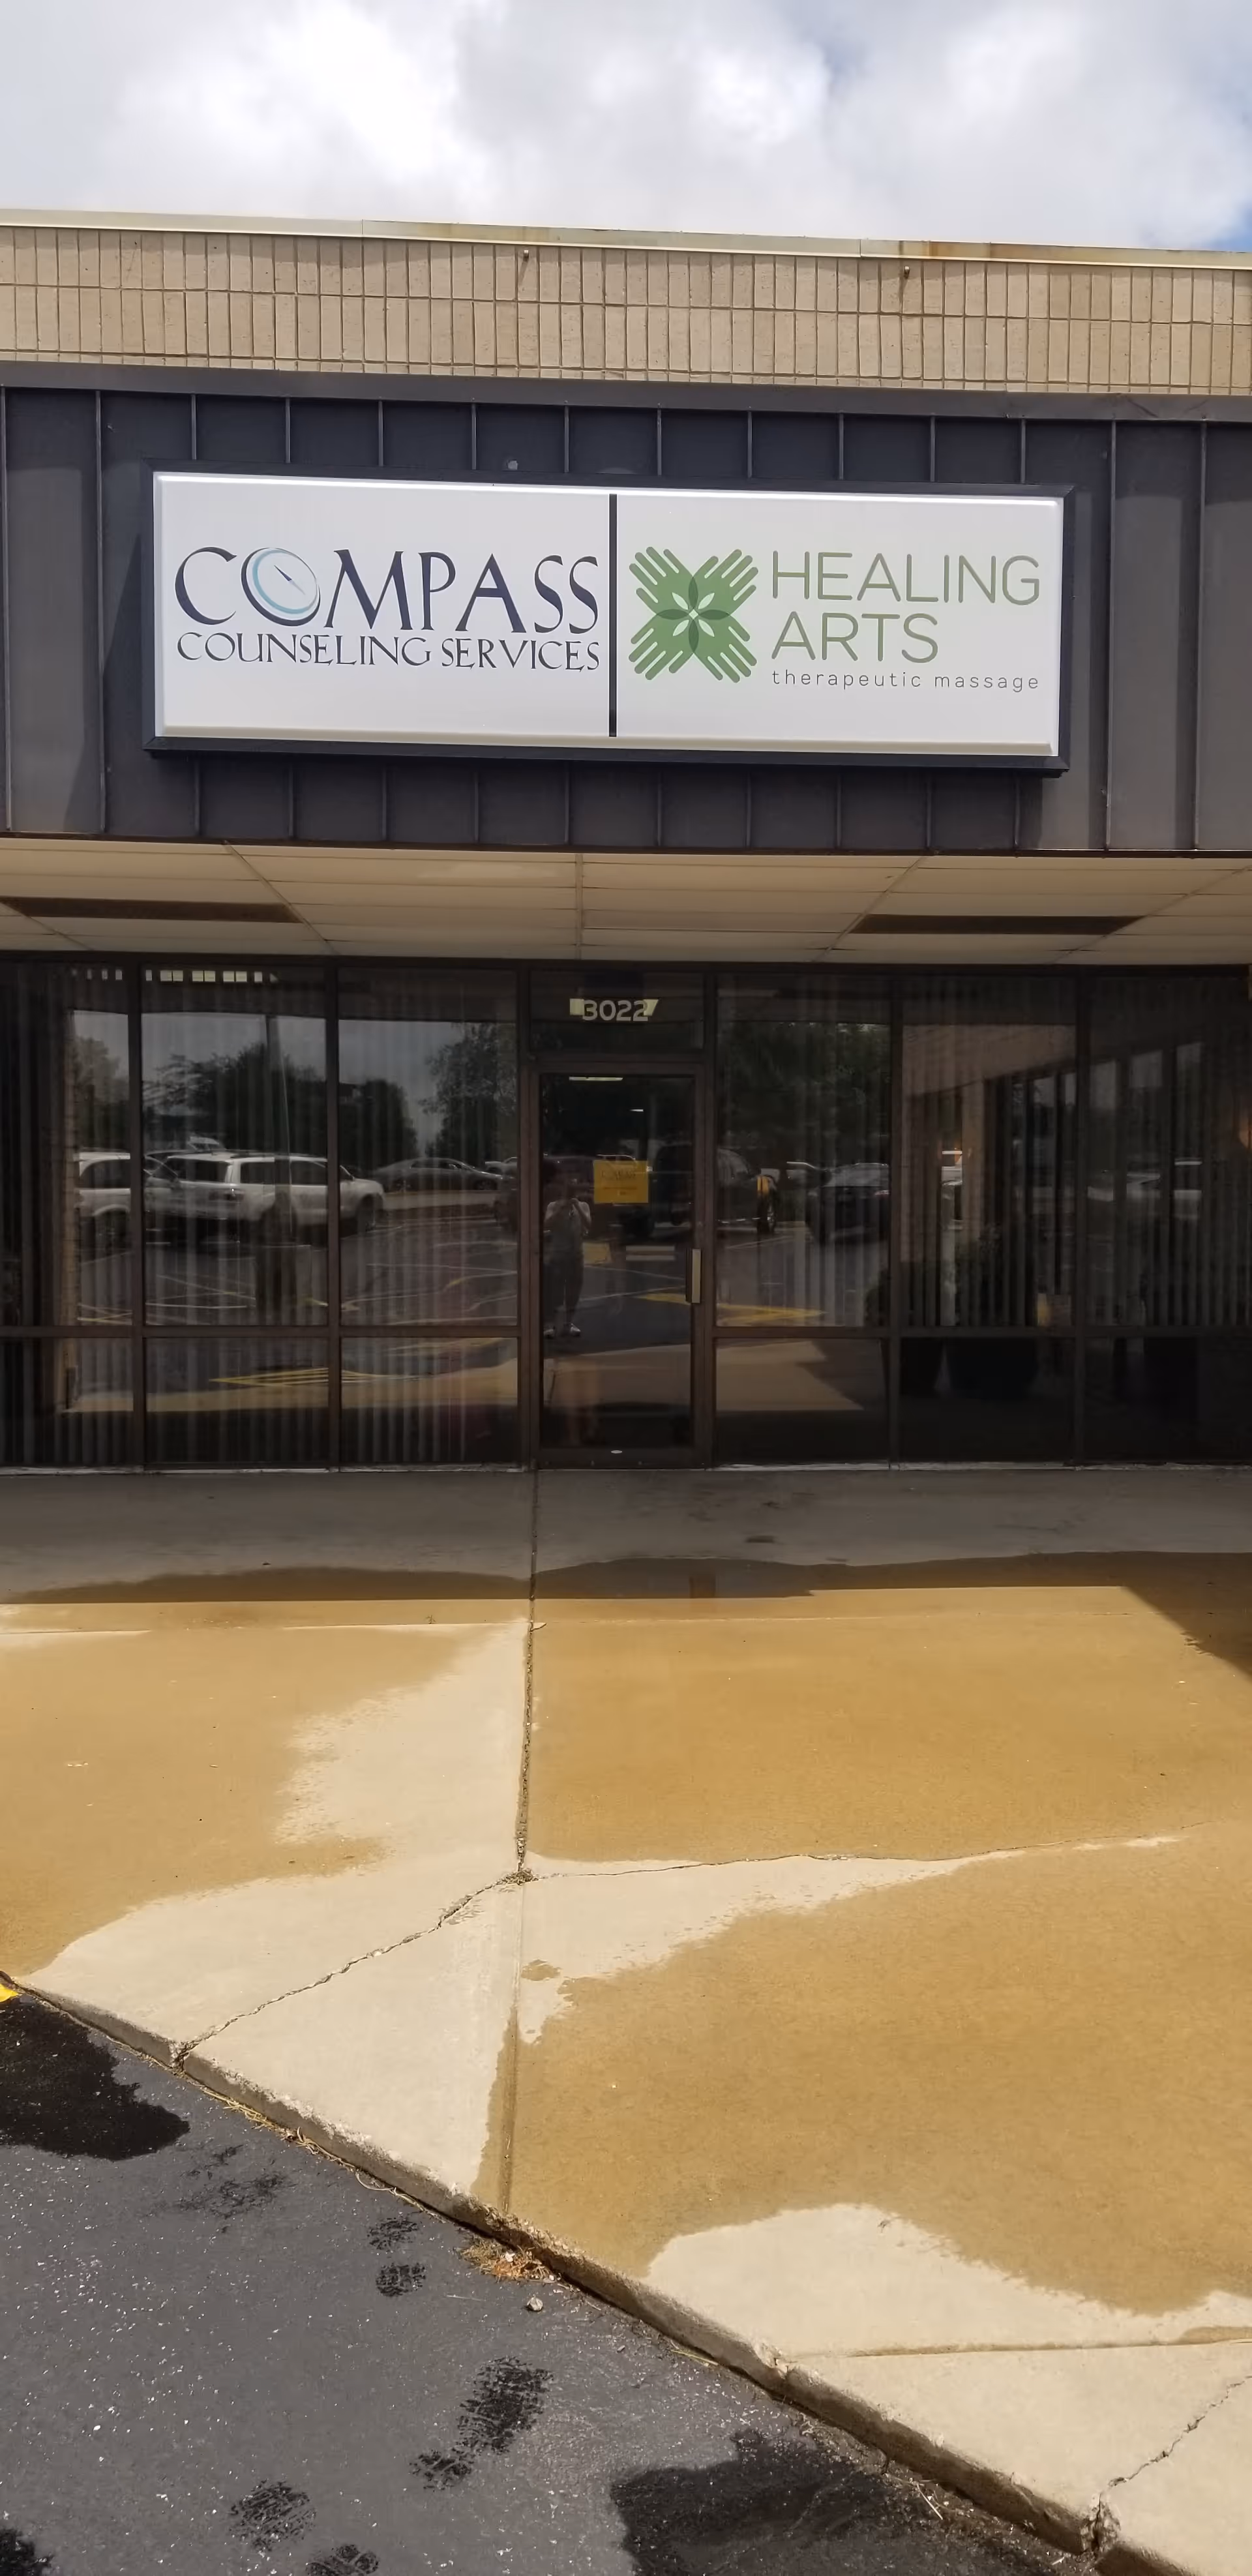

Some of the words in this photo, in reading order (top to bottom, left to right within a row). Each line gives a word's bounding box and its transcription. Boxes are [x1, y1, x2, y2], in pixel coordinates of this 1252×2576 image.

[174, 547, 599, 634] COMPASS
[772, 550, 1040, 606] HEALING
[177, 632, 431, 666] COUNSELING
[441, 638, 600, 672] SERVICES
[771, 611, 938, 664] ARTS
[772, 670, 921, 690] therapeutic
[934, 676, 1039, 693] massage
[582, 999, 648, 1021] 3022
